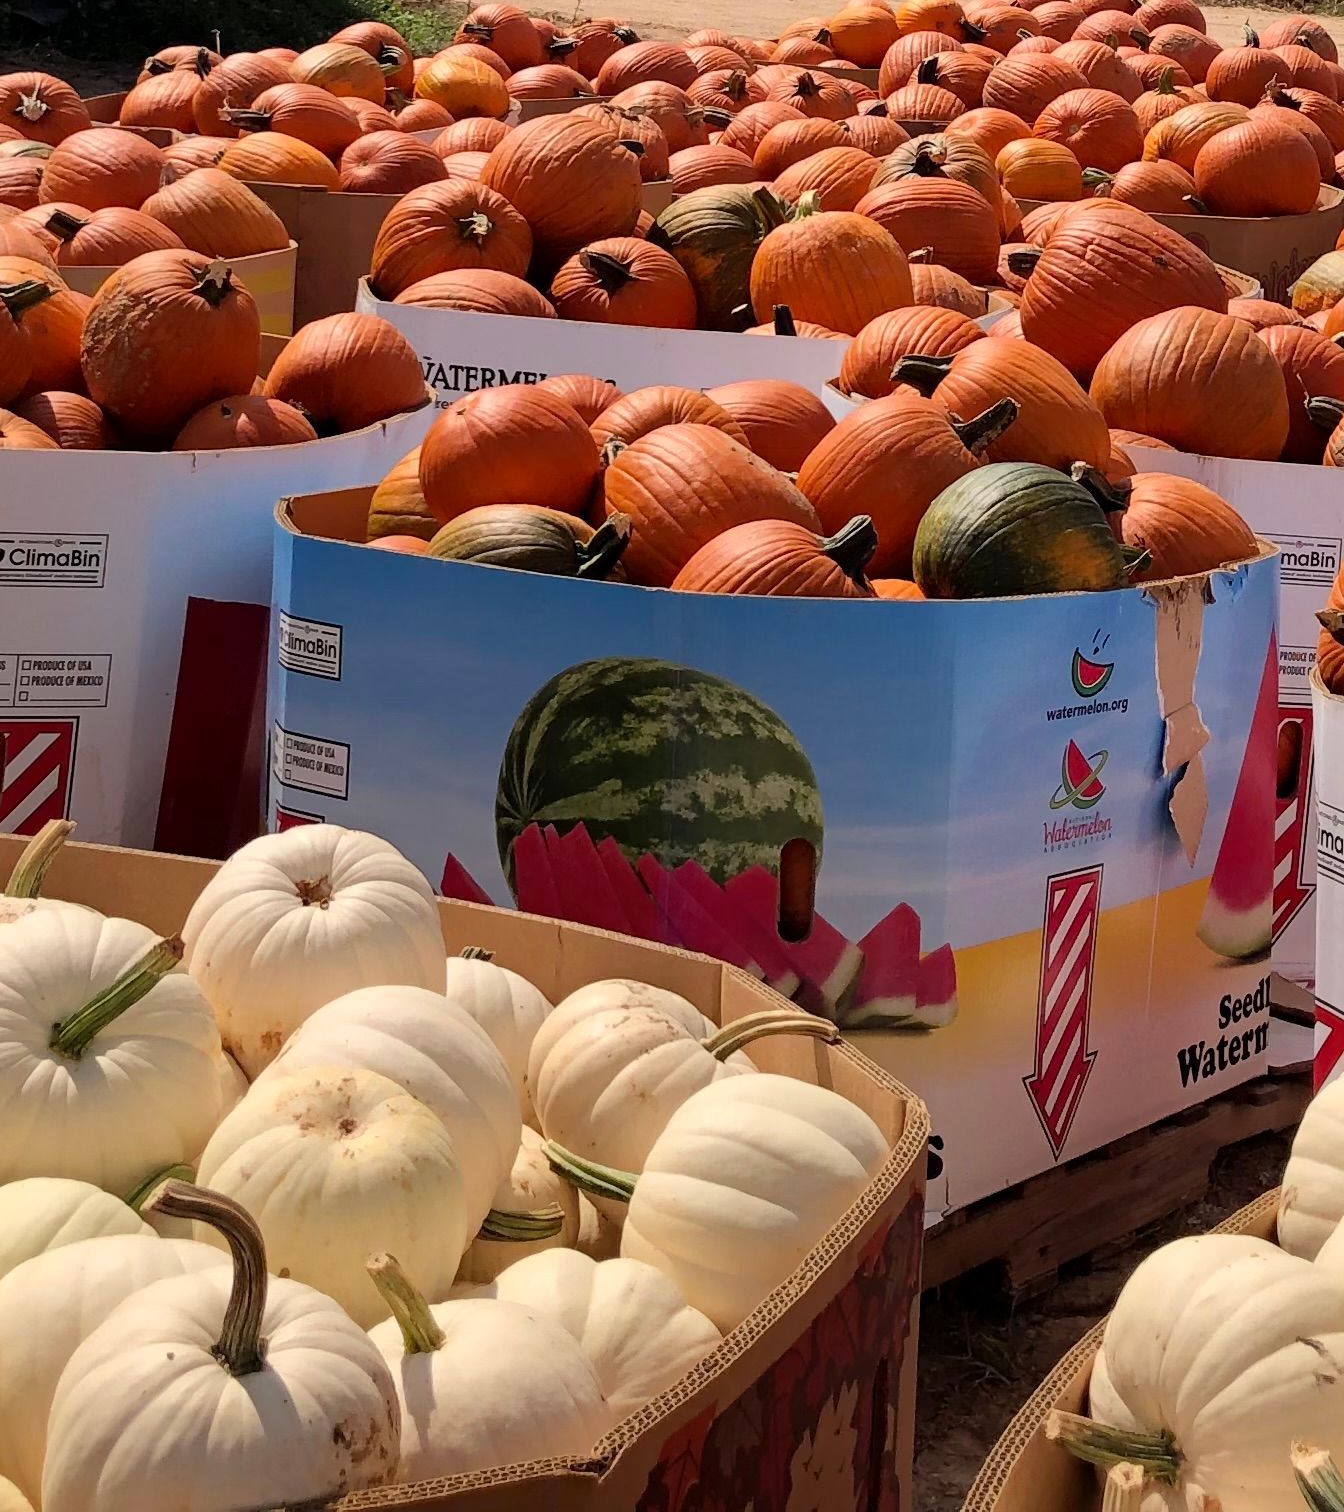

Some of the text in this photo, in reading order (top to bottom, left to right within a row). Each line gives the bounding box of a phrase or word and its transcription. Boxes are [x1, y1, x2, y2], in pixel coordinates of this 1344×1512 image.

[9, 548, 100, 567] ClimaBin
[1280, 652, 1307, 662] PRODUCE
[32, 661, 92, 671] PRODUCE OF USA
[31, 676, 103, 686] PRODUCE OF MEXICO
[1046, 698, 1128, 722] watermelon.org
[1043, 811, 1111, 845] Watermelon
